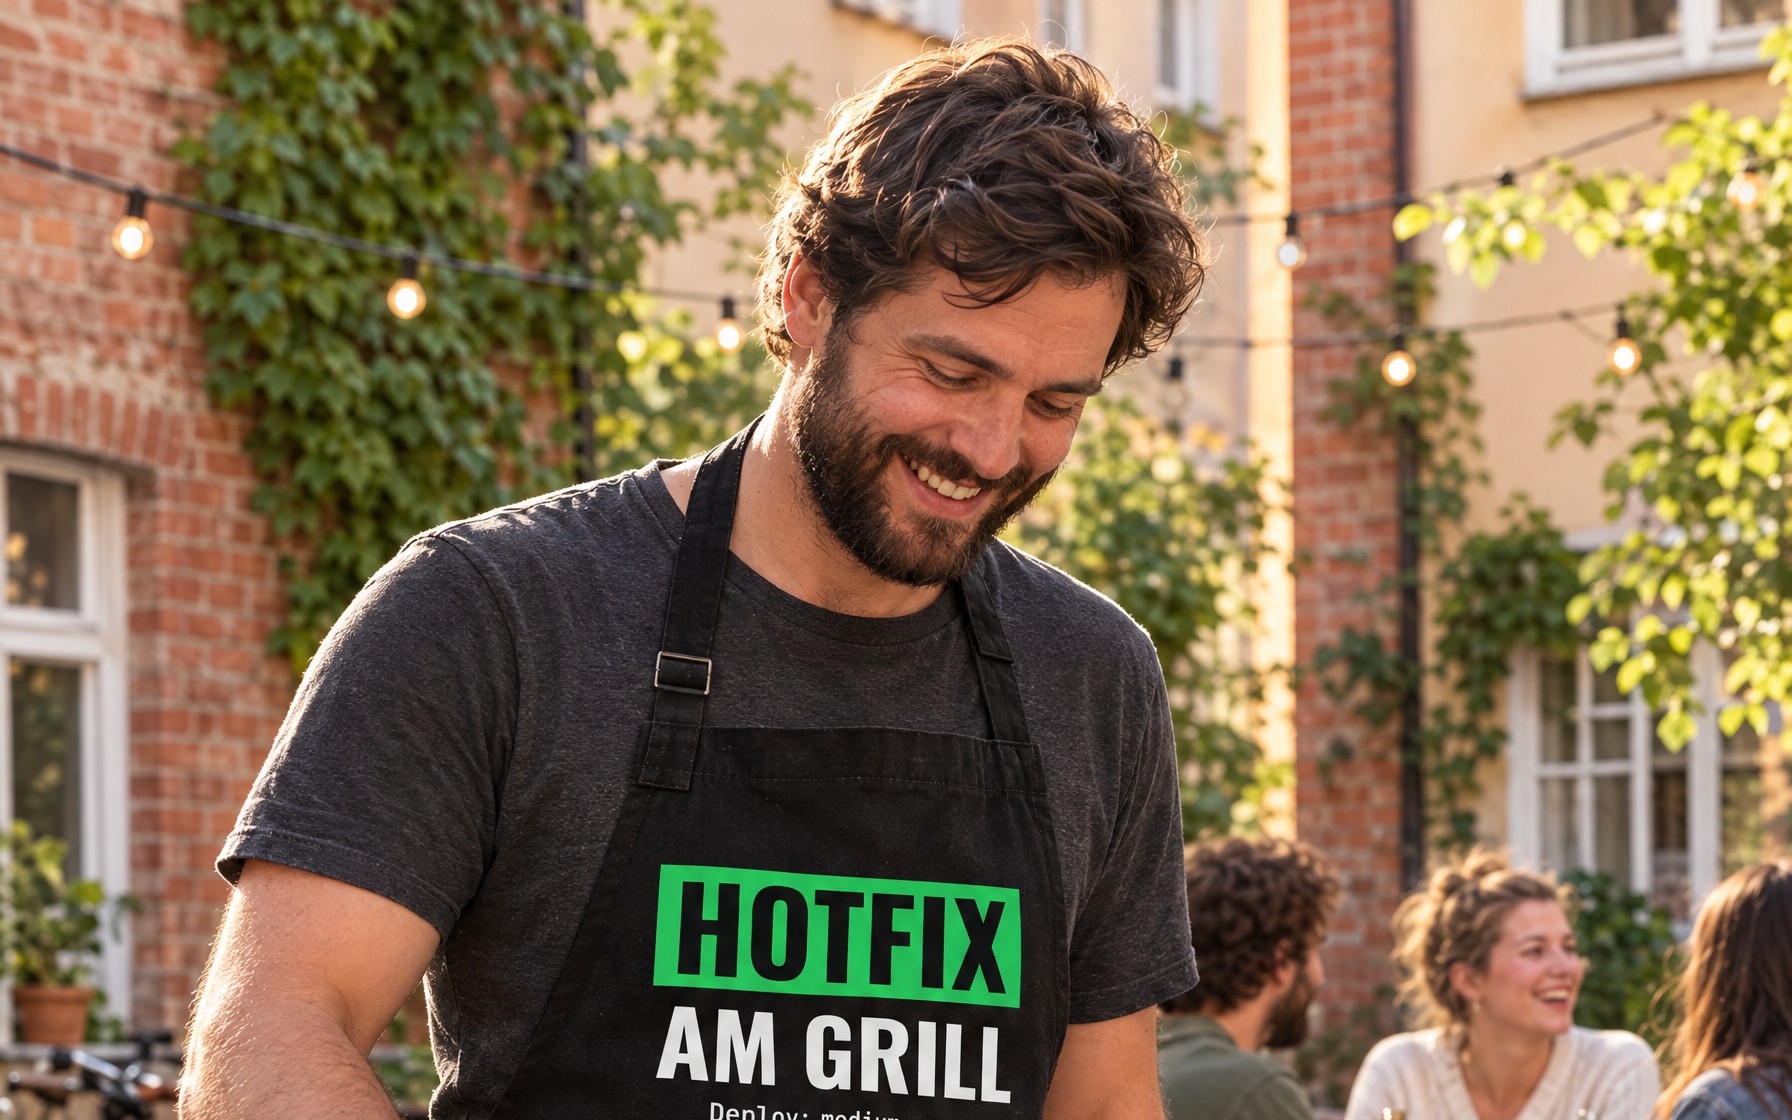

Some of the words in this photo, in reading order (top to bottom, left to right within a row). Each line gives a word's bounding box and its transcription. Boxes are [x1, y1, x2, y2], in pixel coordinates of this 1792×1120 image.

[677, 880, 1007, 995] HOTFIX
[655, 1005, 777, 1087] AM
[805, 1014, 1012, 1105] GRILL
